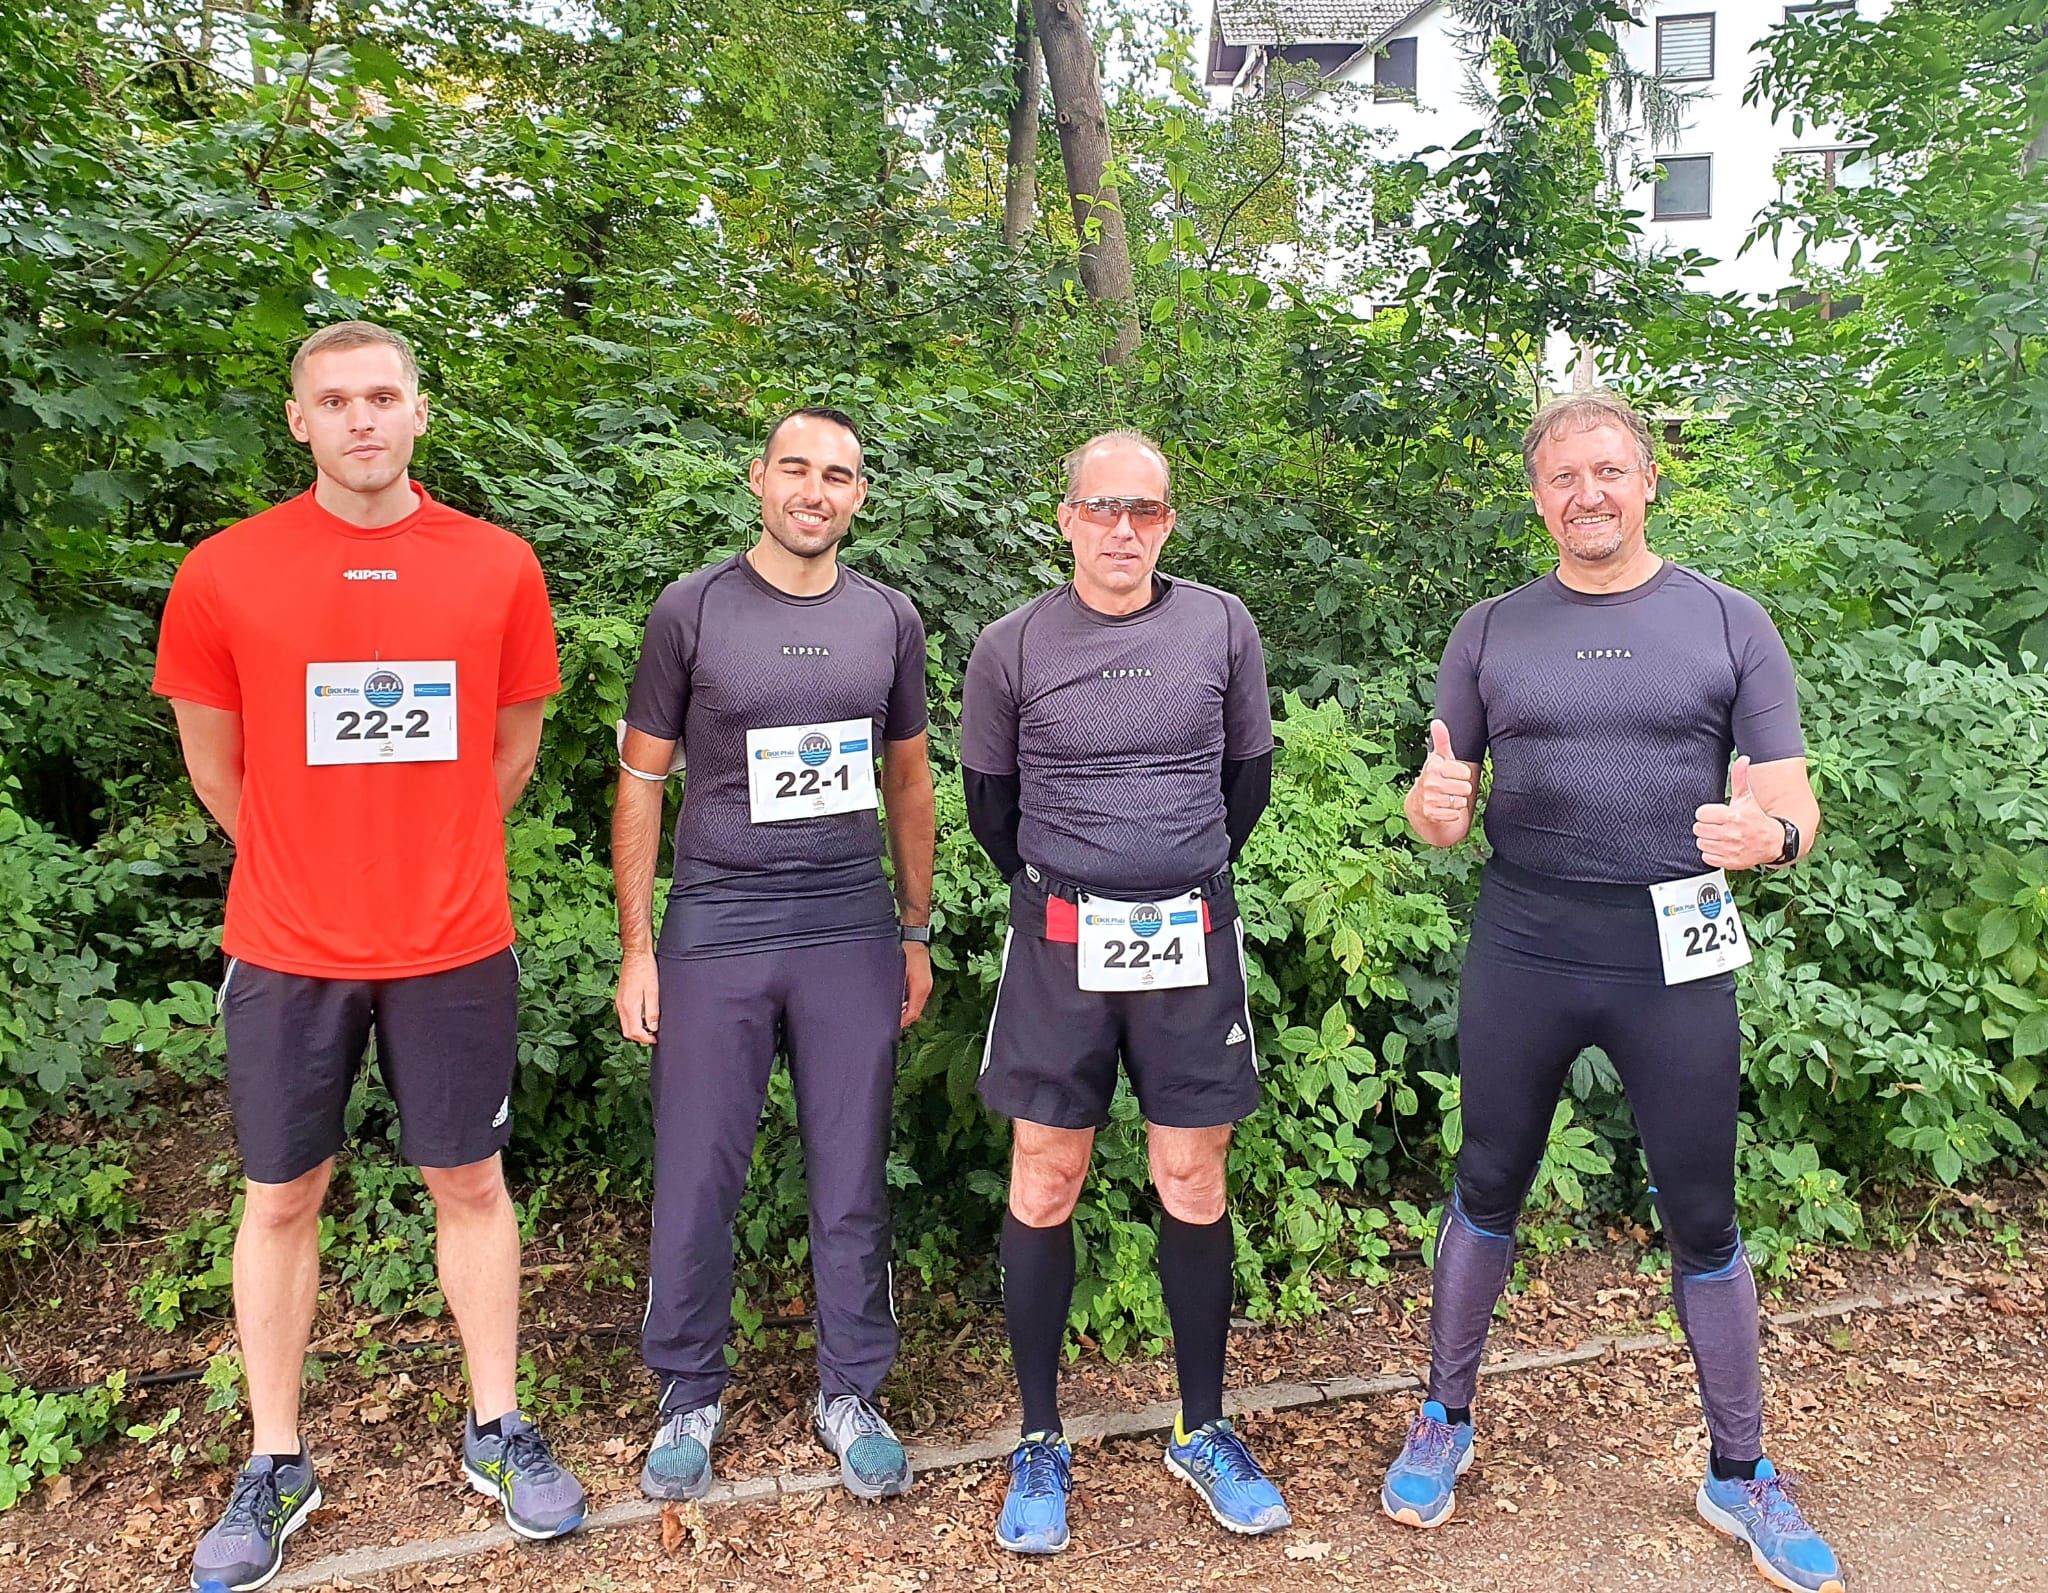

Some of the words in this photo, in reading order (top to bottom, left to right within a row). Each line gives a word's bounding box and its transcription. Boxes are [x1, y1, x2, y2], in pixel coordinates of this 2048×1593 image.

[783, 646, 829, 656] KIPSTA
[1577, 649, 1632, 660] KIPSTA
[1102, 668, 1152, 679] KIPSTA
[335, 709, 430, 740] 22-2
[775, 764, 848, 798] 22-1
[1103, 936, 1183, 968] 22-4
[1683, 916, 1737, 957] 22-3
